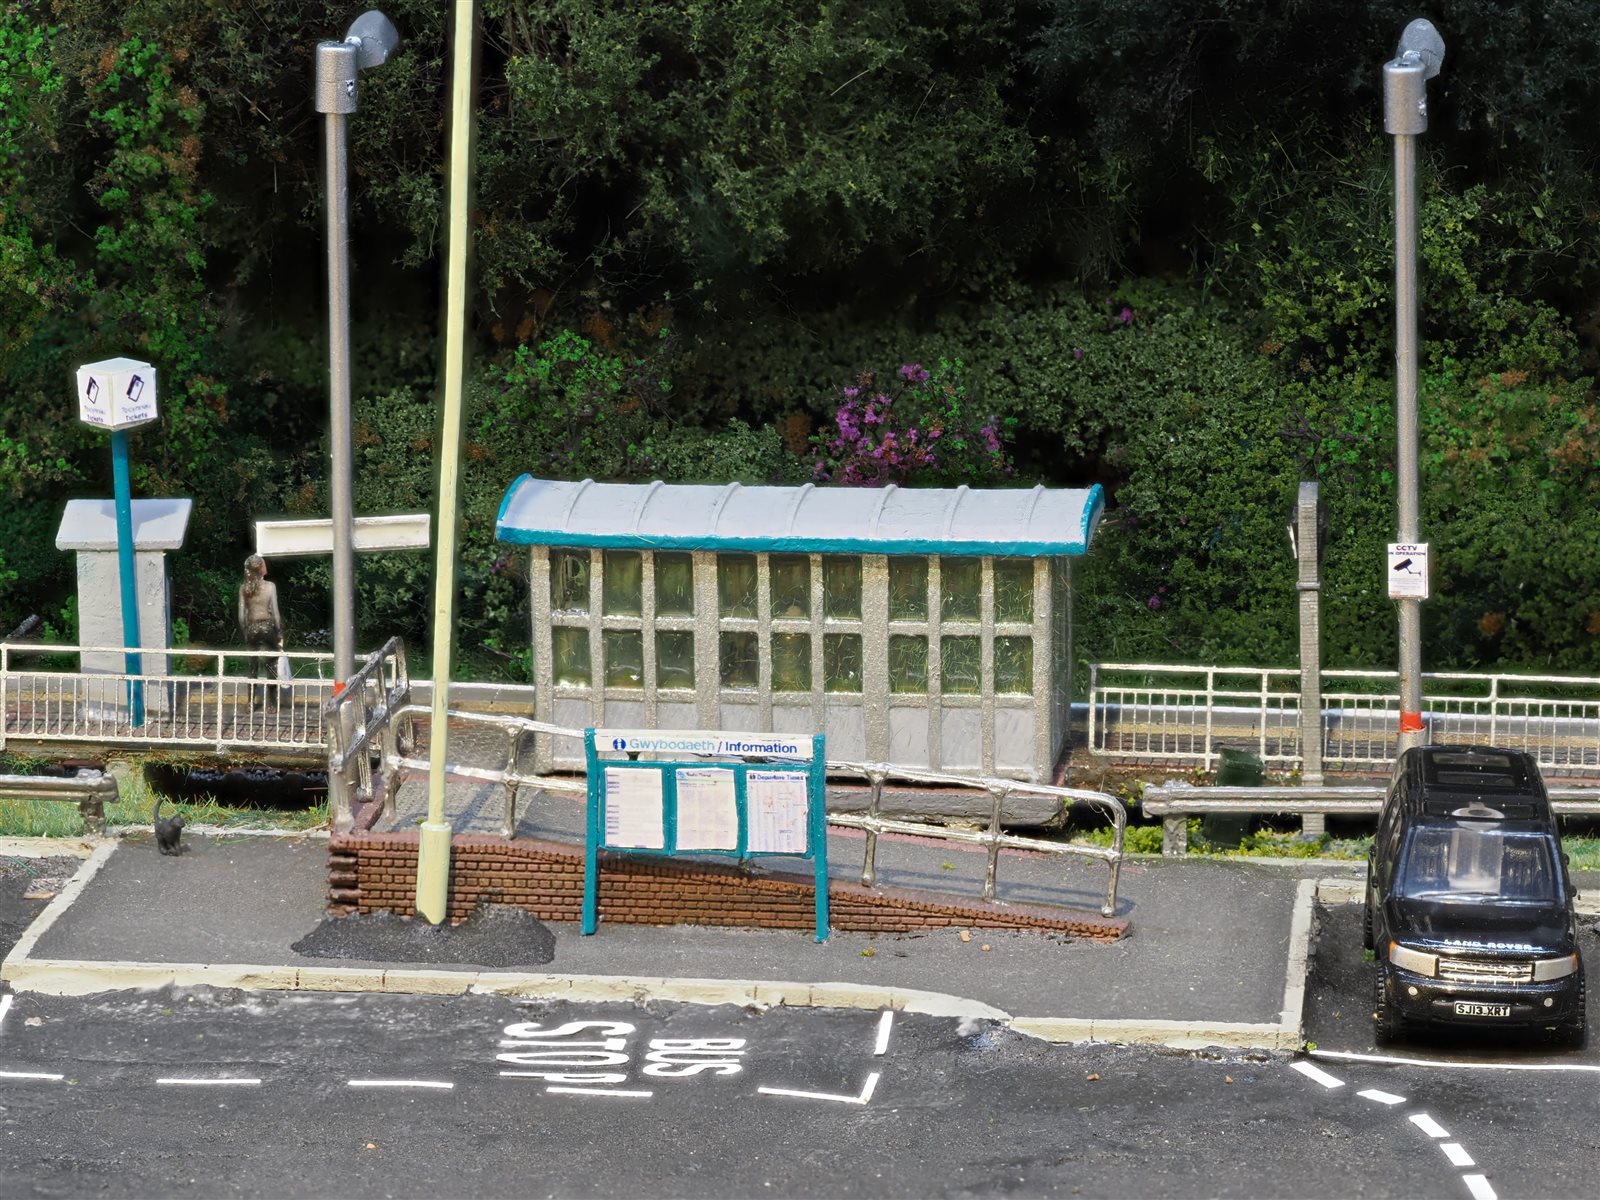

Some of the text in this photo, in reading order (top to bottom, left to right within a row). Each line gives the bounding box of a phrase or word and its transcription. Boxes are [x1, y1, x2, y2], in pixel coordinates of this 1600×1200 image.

[126, 412, 148, 422] Tickets
[629, 738, 715, 751] Gwybodaeth
[725, 741, 798, 754] Information
[1444, 939, 1532, 950] LAND ROVER
[1486, 1005, 1509, 1017] XRT
[495, 1020, 636, 1083] STOP
[642, 1038, 746, 1076] BUS
